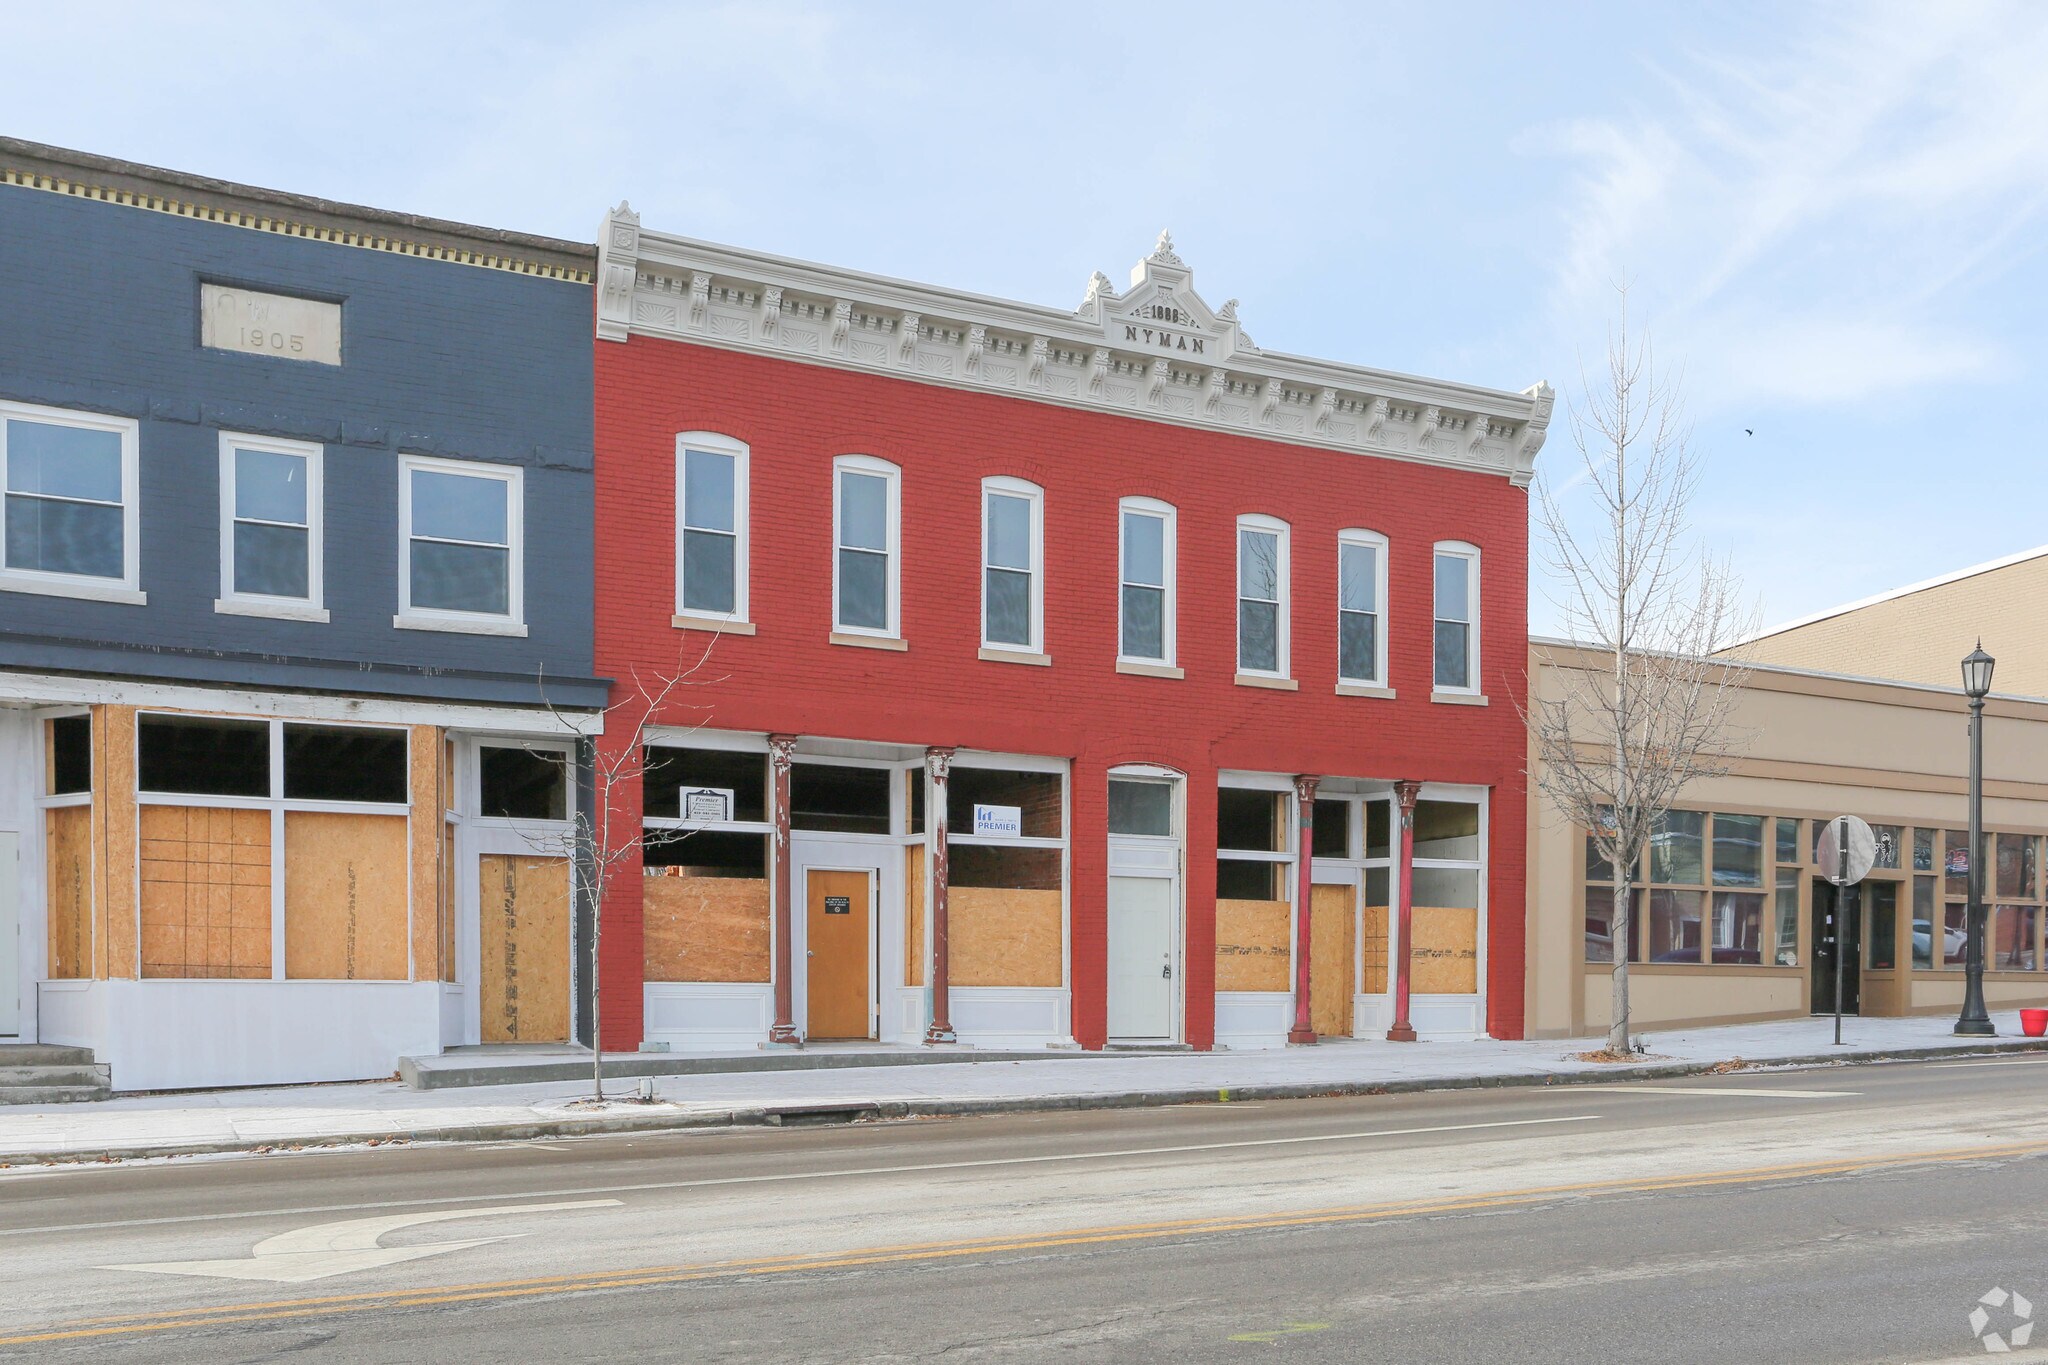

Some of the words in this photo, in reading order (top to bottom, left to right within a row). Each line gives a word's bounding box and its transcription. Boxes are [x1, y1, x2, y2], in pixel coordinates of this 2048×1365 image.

[1152, 304, 1179, 324] 1888
[240, 327, 305, 352] 1905
[1125, 325, 1204, 354] NYMAN
[978, 821, 1017, 831] PREMIER
